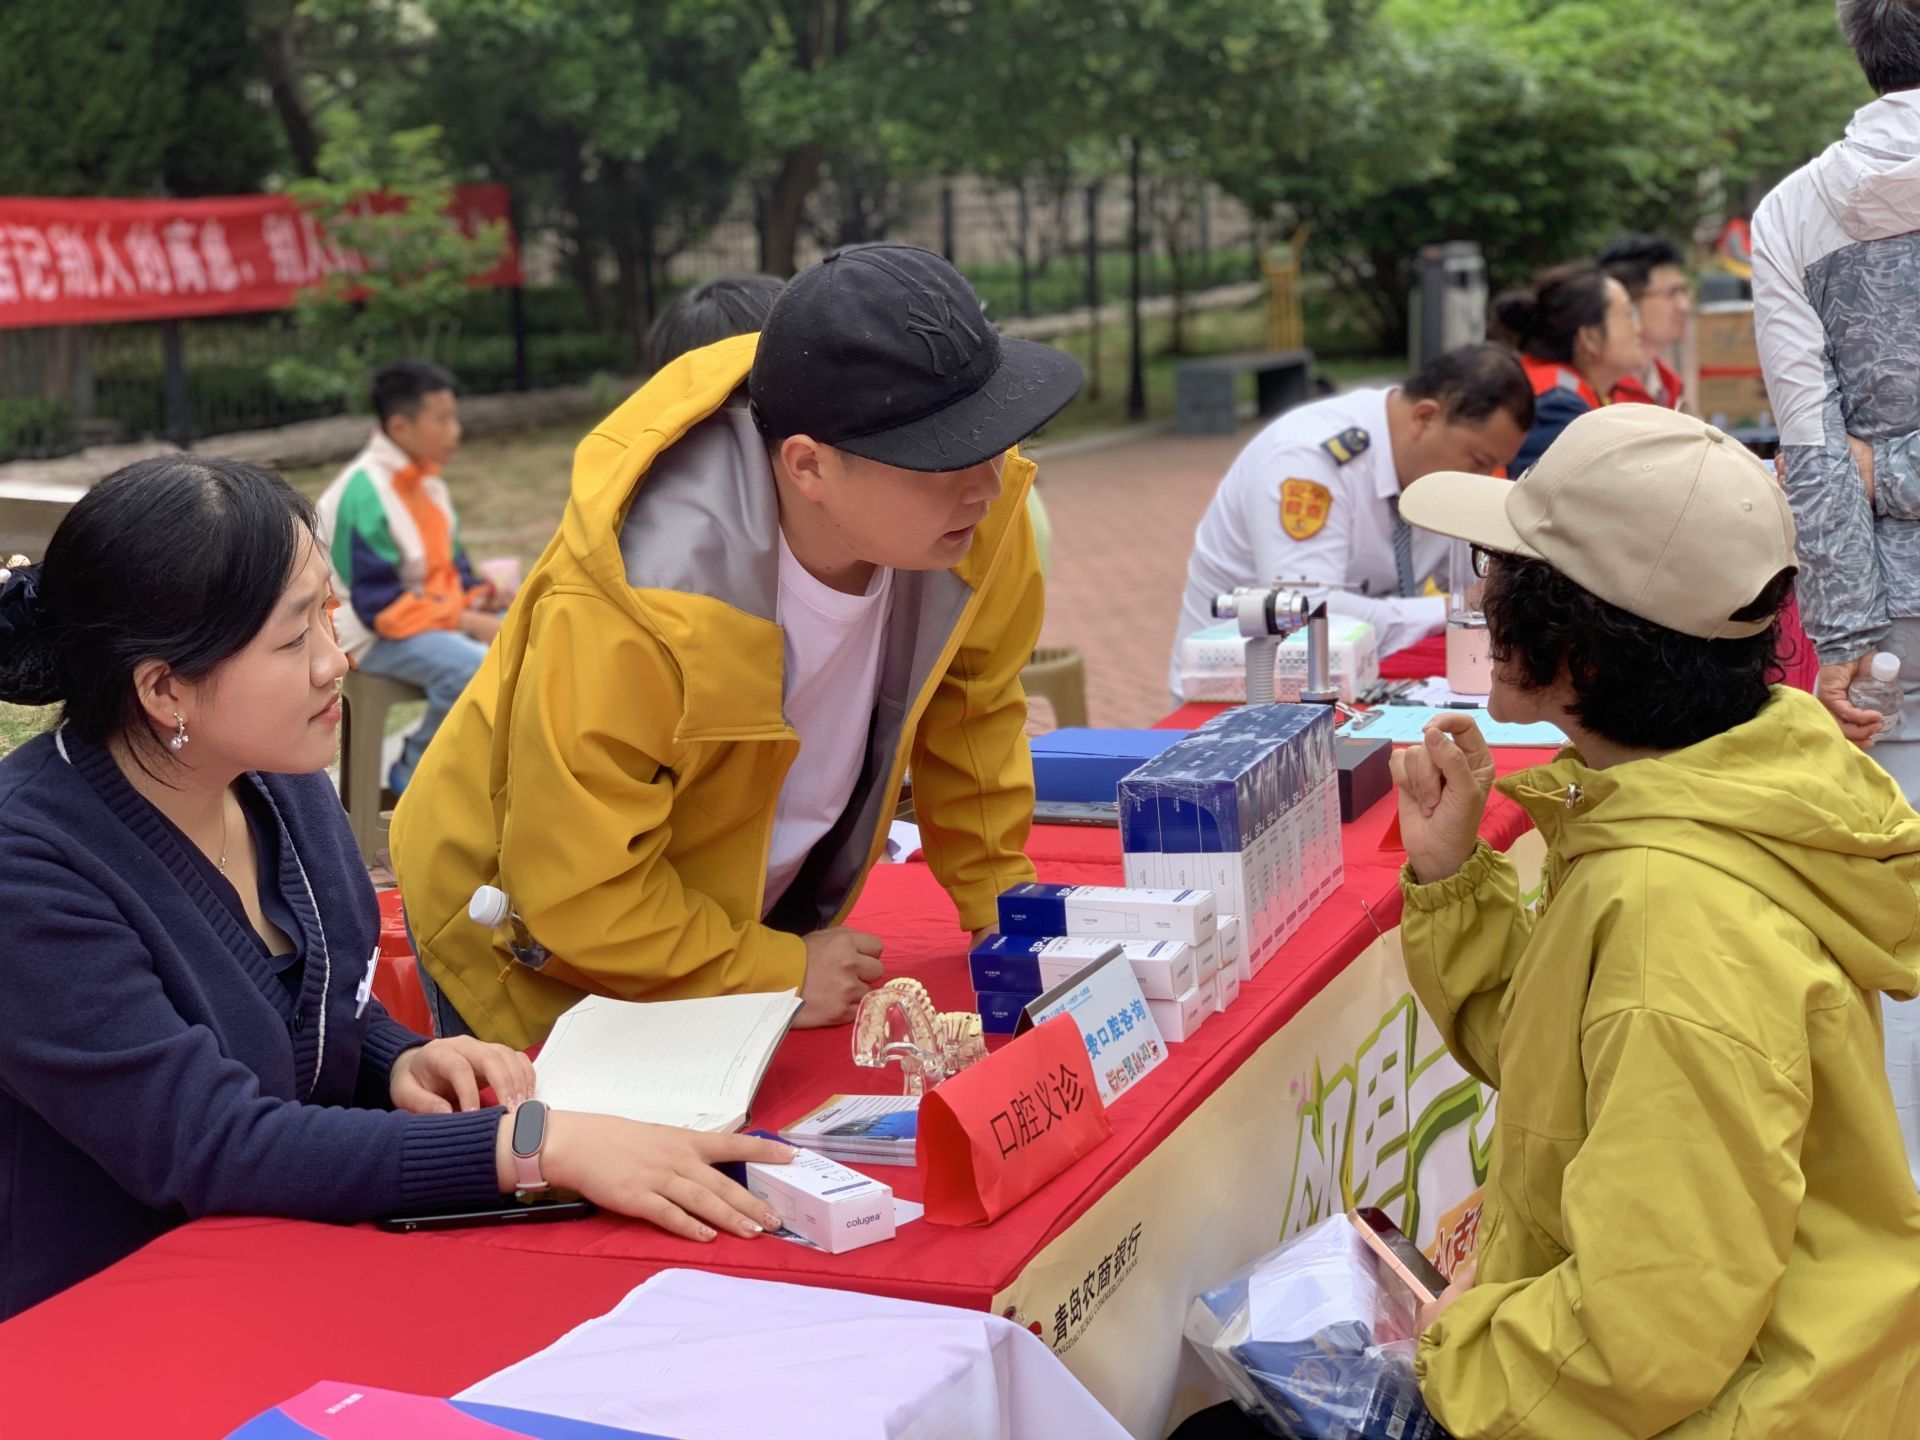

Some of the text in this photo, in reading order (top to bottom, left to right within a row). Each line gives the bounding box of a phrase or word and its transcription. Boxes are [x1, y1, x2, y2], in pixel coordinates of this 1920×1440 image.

[990, 1063, 1084, 1161] 口腔义诊
[846, 1212, 881, 1229] colugea
[1053, 1221, 1142, 1347] 青岛农商银行
